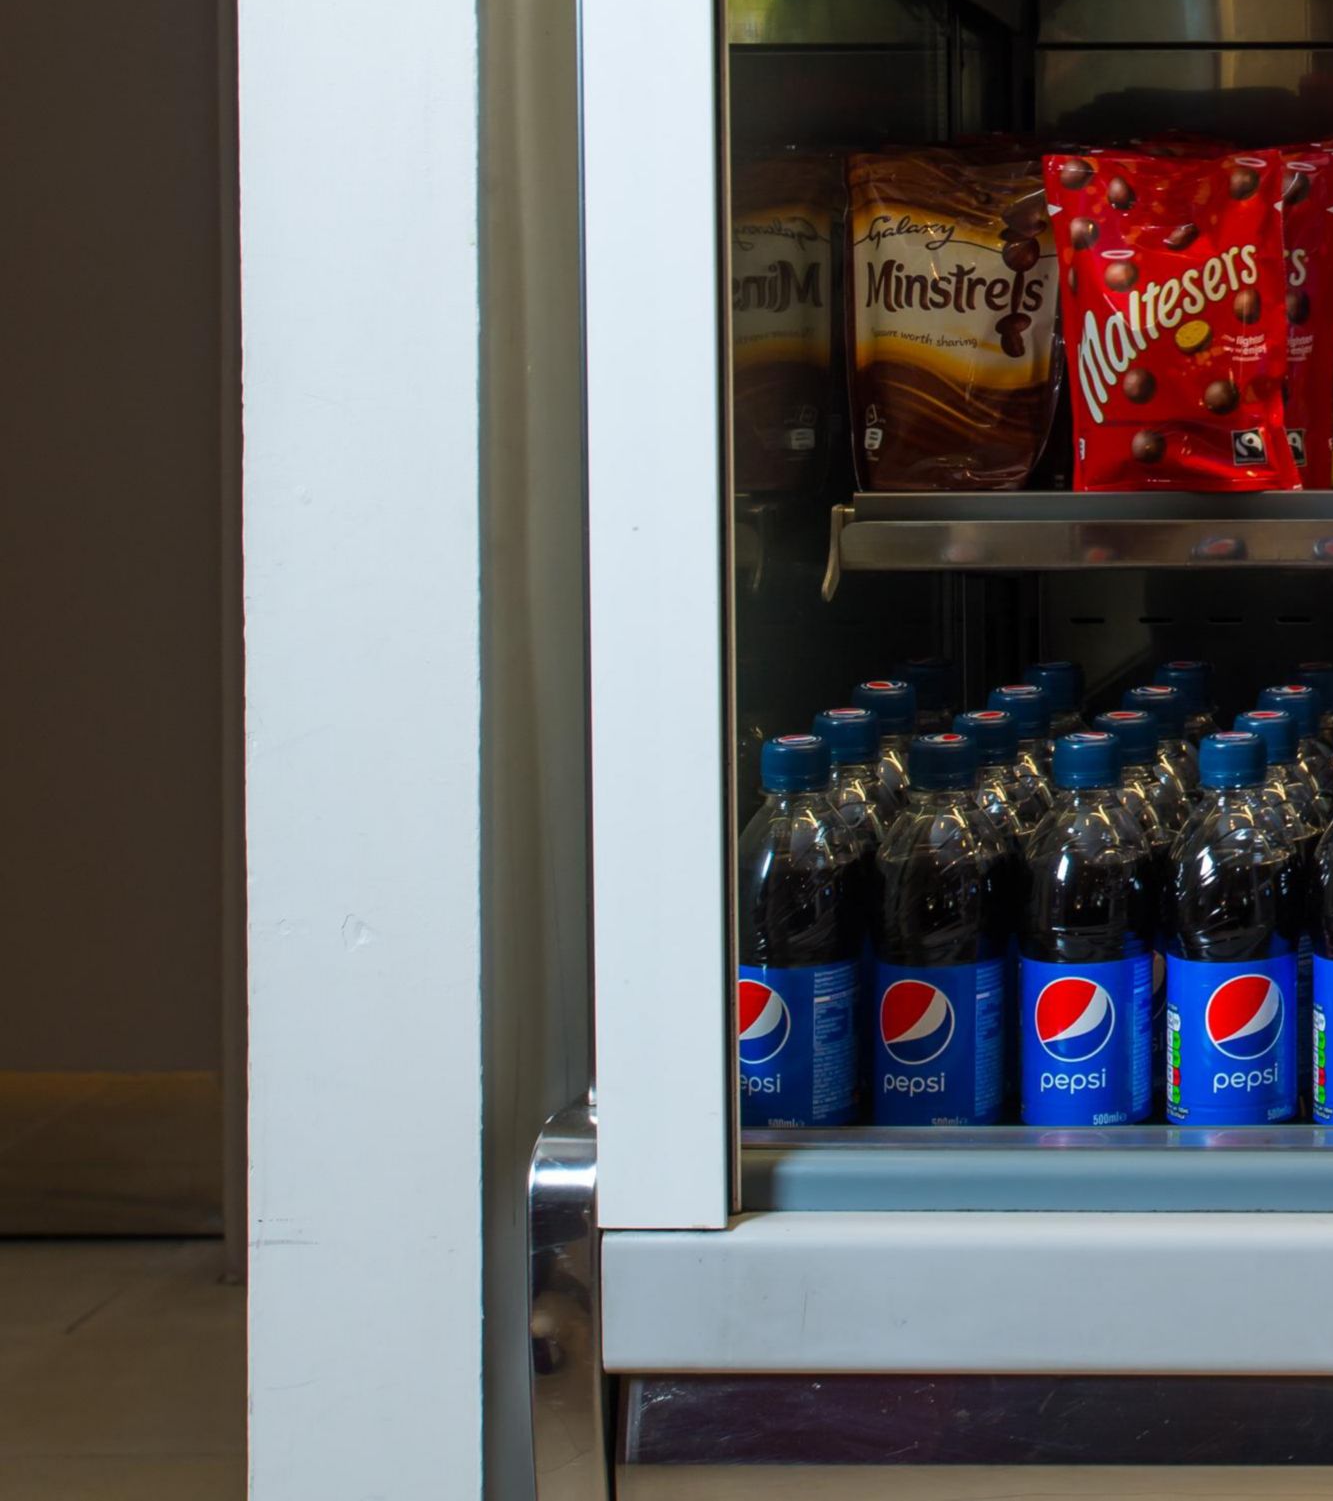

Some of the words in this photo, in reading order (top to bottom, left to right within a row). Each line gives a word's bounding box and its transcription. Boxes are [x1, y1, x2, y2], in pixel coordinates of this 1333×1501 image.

[867, 215, 956, 250] Galaxy
[866, 258, 1045, 313] Minstrels
[901, 331, 933, 346] worth
[936, 334, 978, 349] sharing
[1078, 244, 1259, 424] Maltesers
[883, 1072, 946, 1097] pepsi
[1040, 1067, 1107, 1095] pepsi
[1212, 1061, 1279, 1094] pepsi
[1092, 1113, 1120, 1126] 500ml
